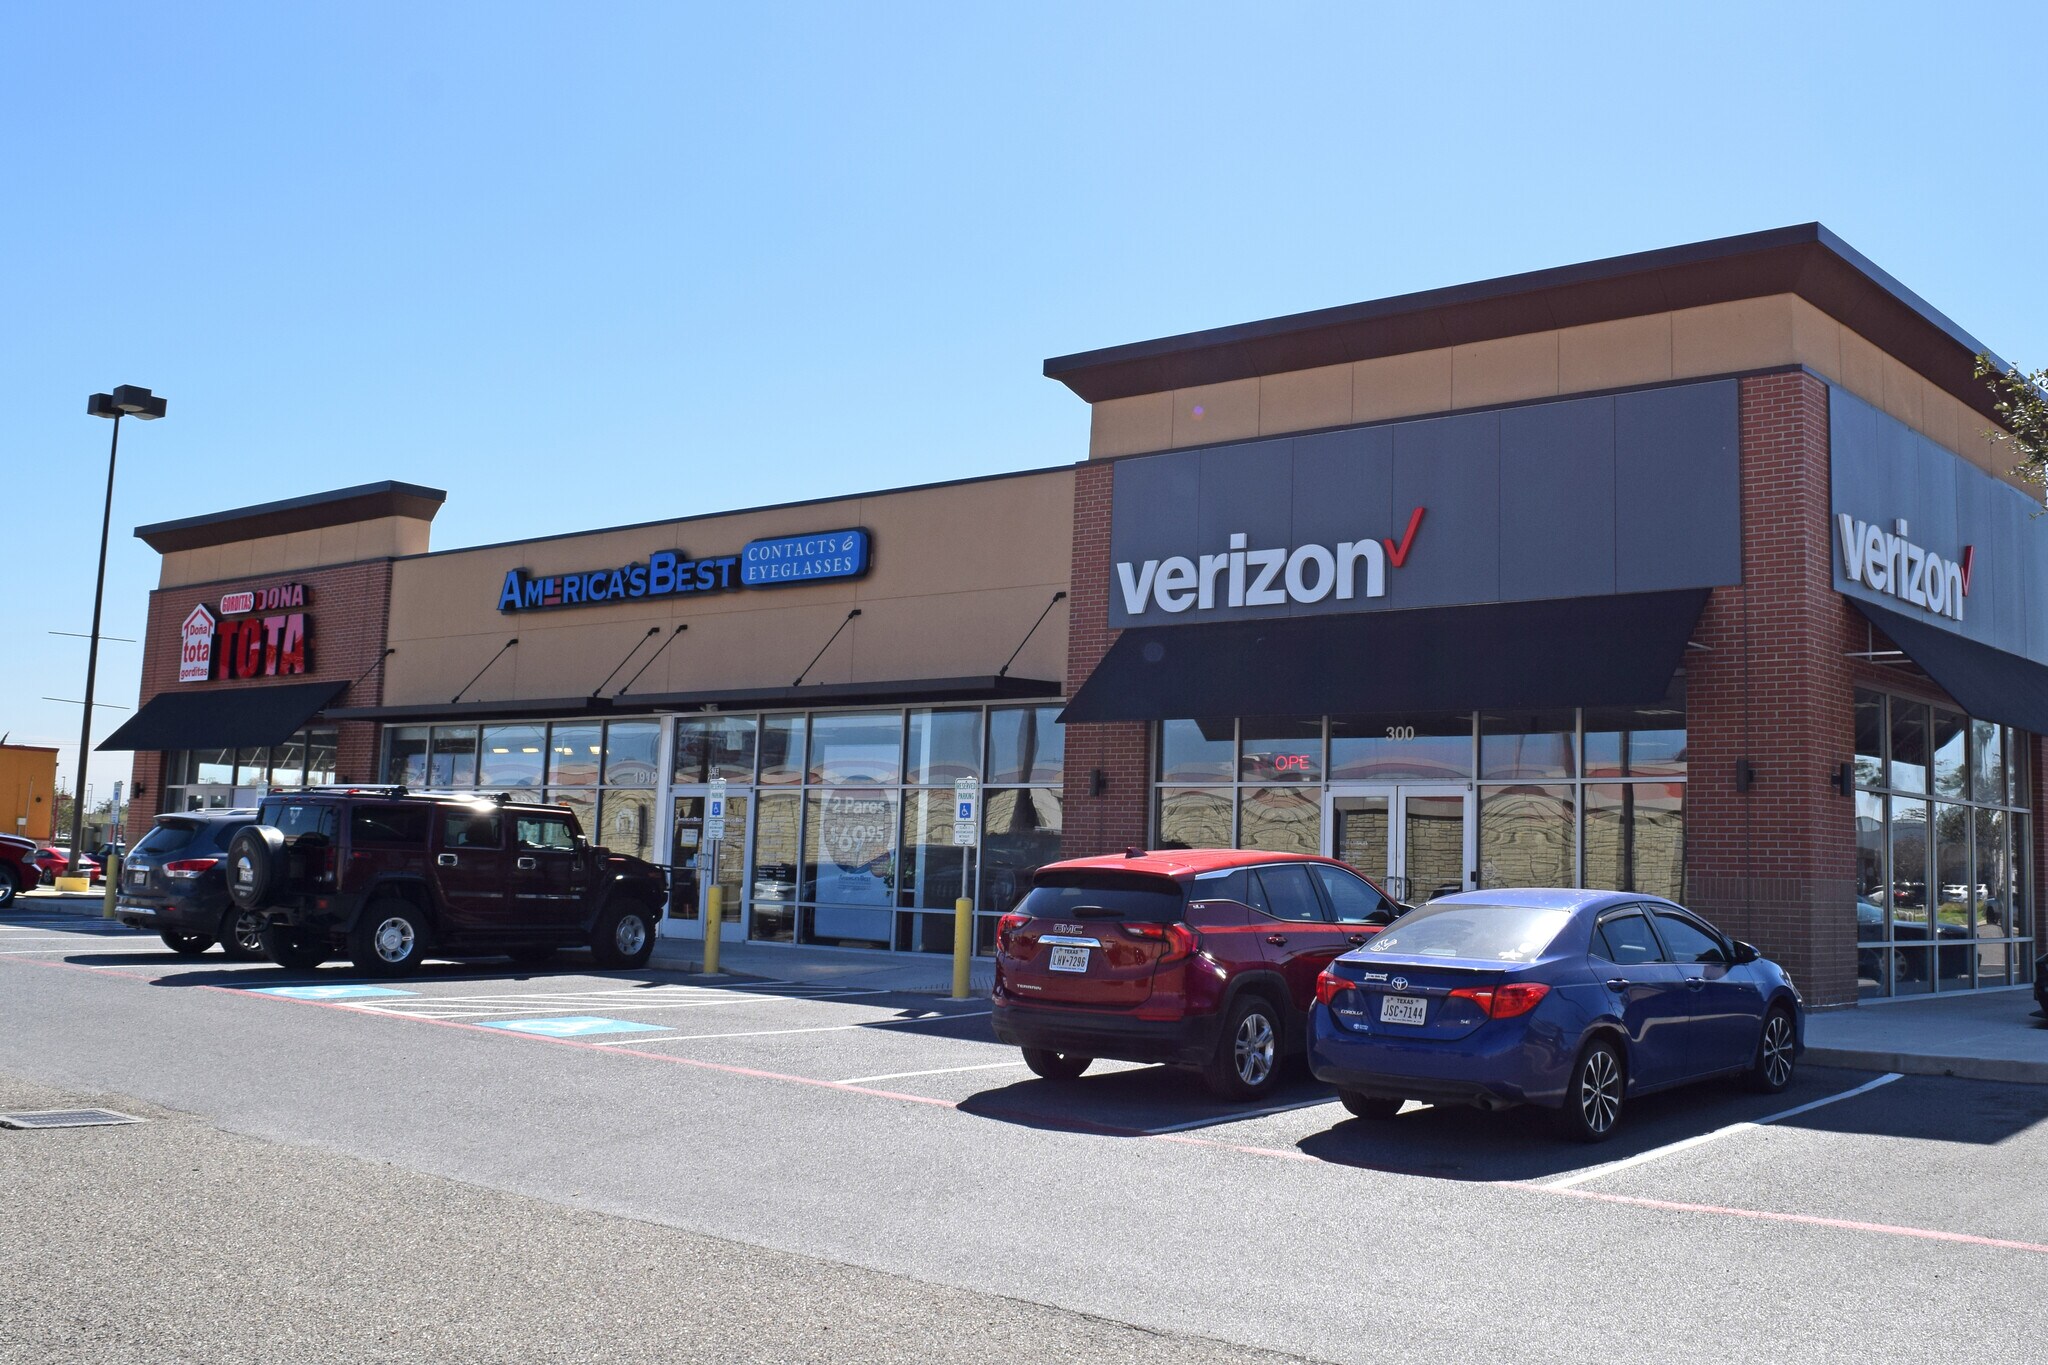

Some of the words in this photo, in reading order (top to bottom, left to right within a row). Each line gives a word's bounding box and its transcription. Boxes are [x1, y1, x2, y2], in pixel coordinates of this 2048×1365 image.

[748, 539, 835, 561] CONTACTS
[842, 535, 853, 551] &
[749, 557, 852, 580] EYEGLASSES
[1116, 532, 1385, 615] verizon
[1837, 513, 1963, 621] verizon
[499, 564, 647, 610] AMERICA'S
[649, 552, 736, 594] BEST
[222, 594, 252, 612] GORDITAS
[256, 583, 303, 610] DOÑA
[190, 624, 207, 636] Doña
[183, 640, 209, 663] tota
[218, 614, 305, 681] TOTA
[180, 667, 208, 681] gorditas
[1386, 726, 1414, 741] 300
[832, 797, 841, 813] 2
[845, 797, 885, 814] Pares
[1053, 924, 1083, 934] GMC
